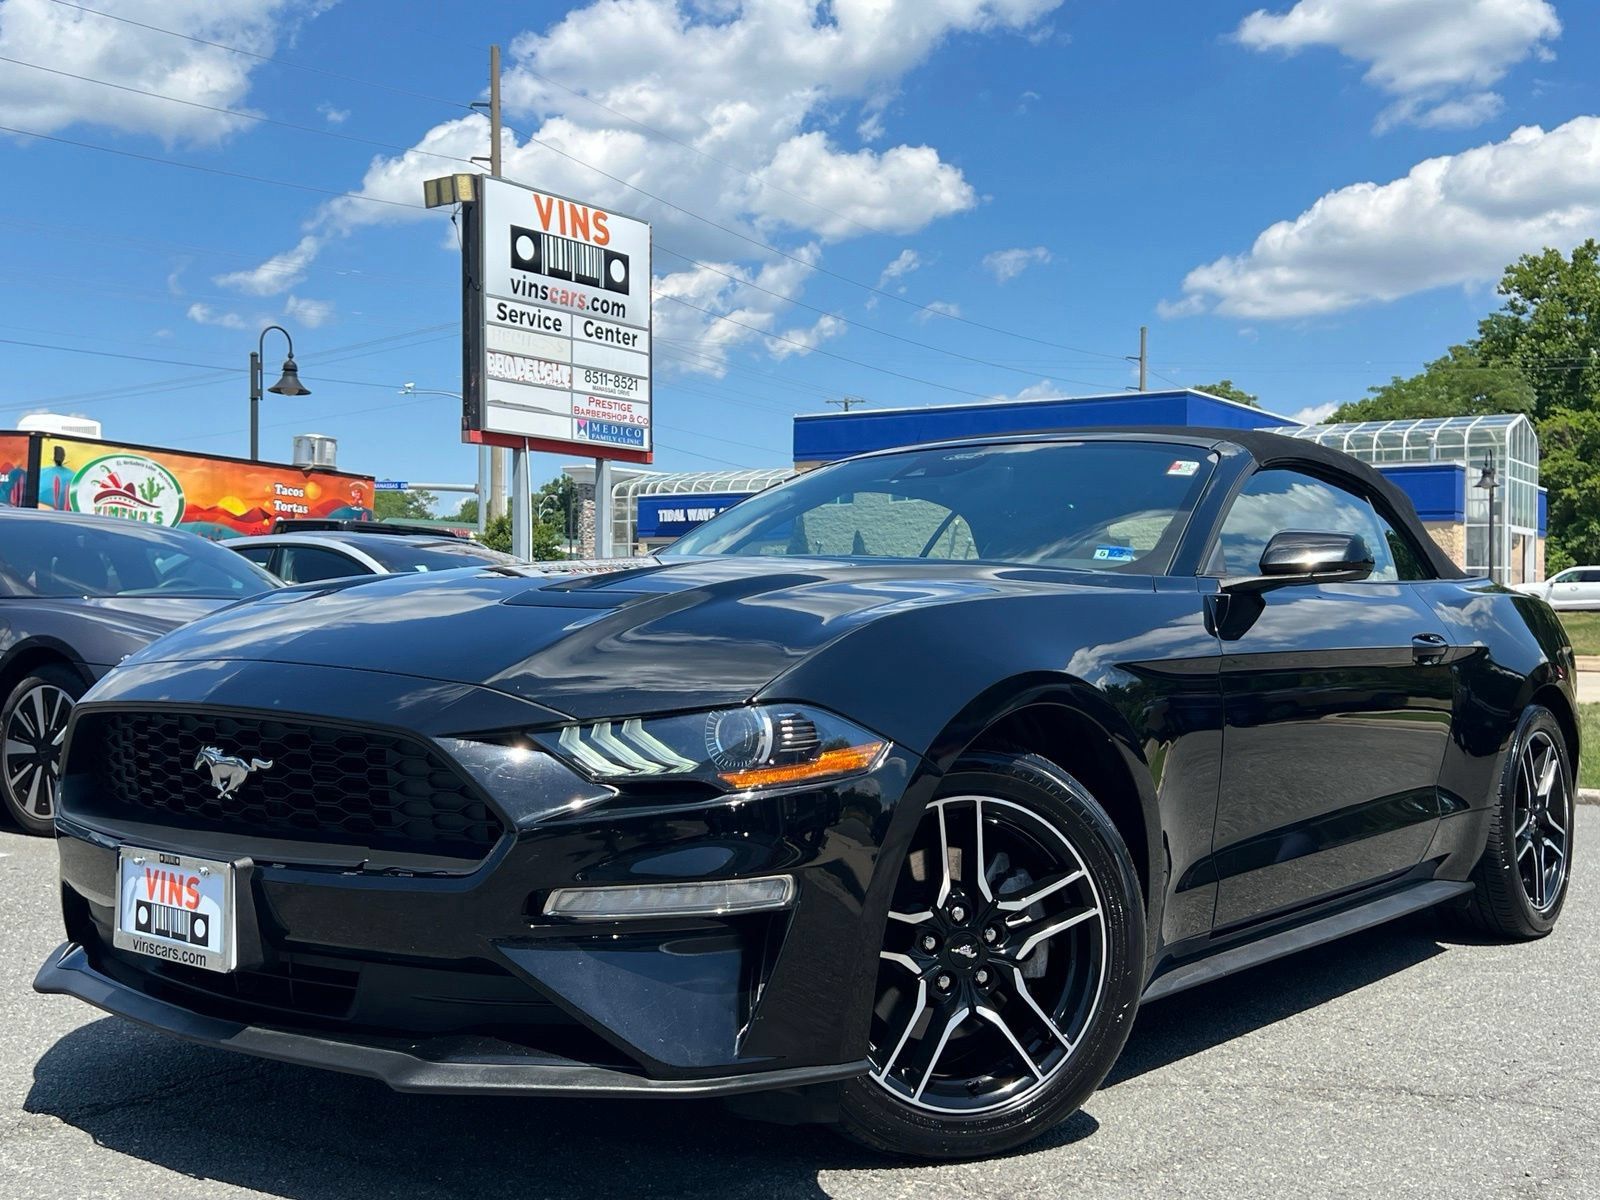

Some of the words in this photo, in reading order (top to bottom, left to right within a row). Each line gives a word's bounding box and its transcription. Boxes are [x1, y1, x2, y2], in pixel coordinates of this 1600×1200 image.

[533, 193, 610, 246] VINS
[510, 275, 626, 318] vinscars.com
[497, 303, 562, 332] Service
[583, 320, 638, 347] Center
[584, 369, 638, 391] 8511-8521
[588, 396, 633, 413] PRESTIGE
[573, 405, 627, 422] BARBERSHOP
[629, 414, 635, 423] &
[591, 422, 642, 438] MEDICO
[591, 433, 618, 442] FAMILY
[618, 436, 642, 445] CLINIC
[274, 483, 304, 497] Tacos
[273, 500, 309, 514] Tortas
[658, 509, 686, 522] TIDAL
[687, 508, 716, 521] WAVE
[146, 867, 200, 910] VINS
[132, 936, 207, 967] vinscars.com
